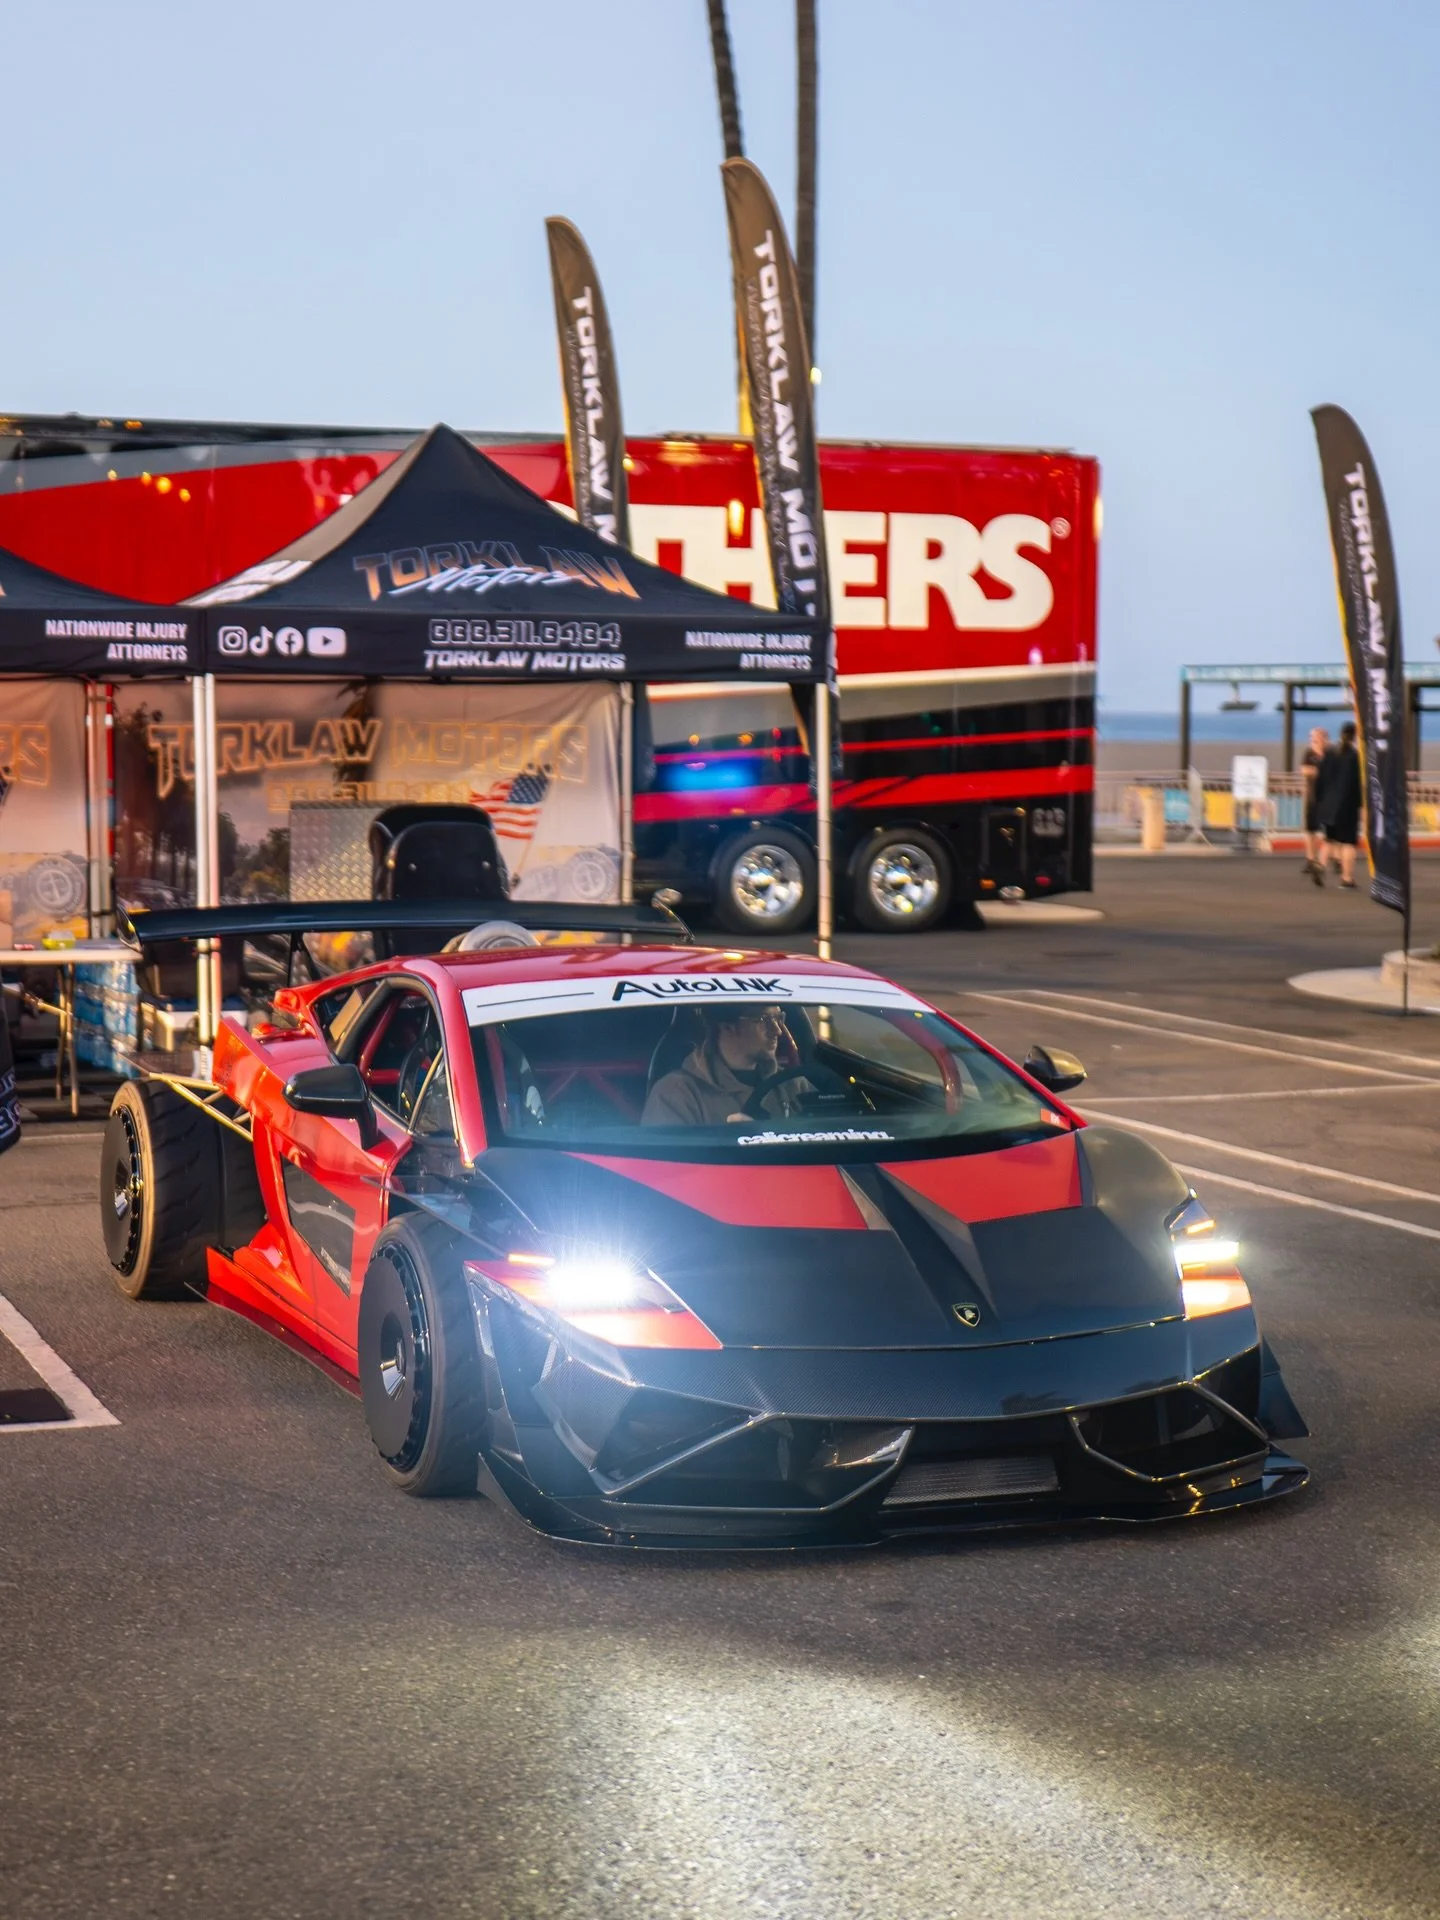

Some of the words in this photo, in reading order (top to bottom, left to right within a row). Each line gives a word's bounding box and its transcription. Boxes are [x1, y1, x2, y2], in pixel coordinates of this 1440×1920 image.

[753, 229, 800, 473] TORKLAW
[572, 286, 614, 500] TORKLAW
[353, 541, 643, 601] TORKLAW
[562, 501, 1055, 632] THERS
[1334, 463, 1386, 657] TORKLAW
[387, 562, 590, 596] Motors
[45, 619, 133, 640] NATIONWIDE
[136, 621, 187, 641] INJURY
[685, 631, 764, 649] NATIONWIDE
[765, 633, 812, 651] INJURY
[107, 643, 188, 662] ATTORNEYS
[424, 650, 528, 670] TORKLAW
[531, 652, 626, 672] MOTORS
[740, 653, 812, 671] ATTORNEYS
[612, 978, 794, 1001] AutoLNK
